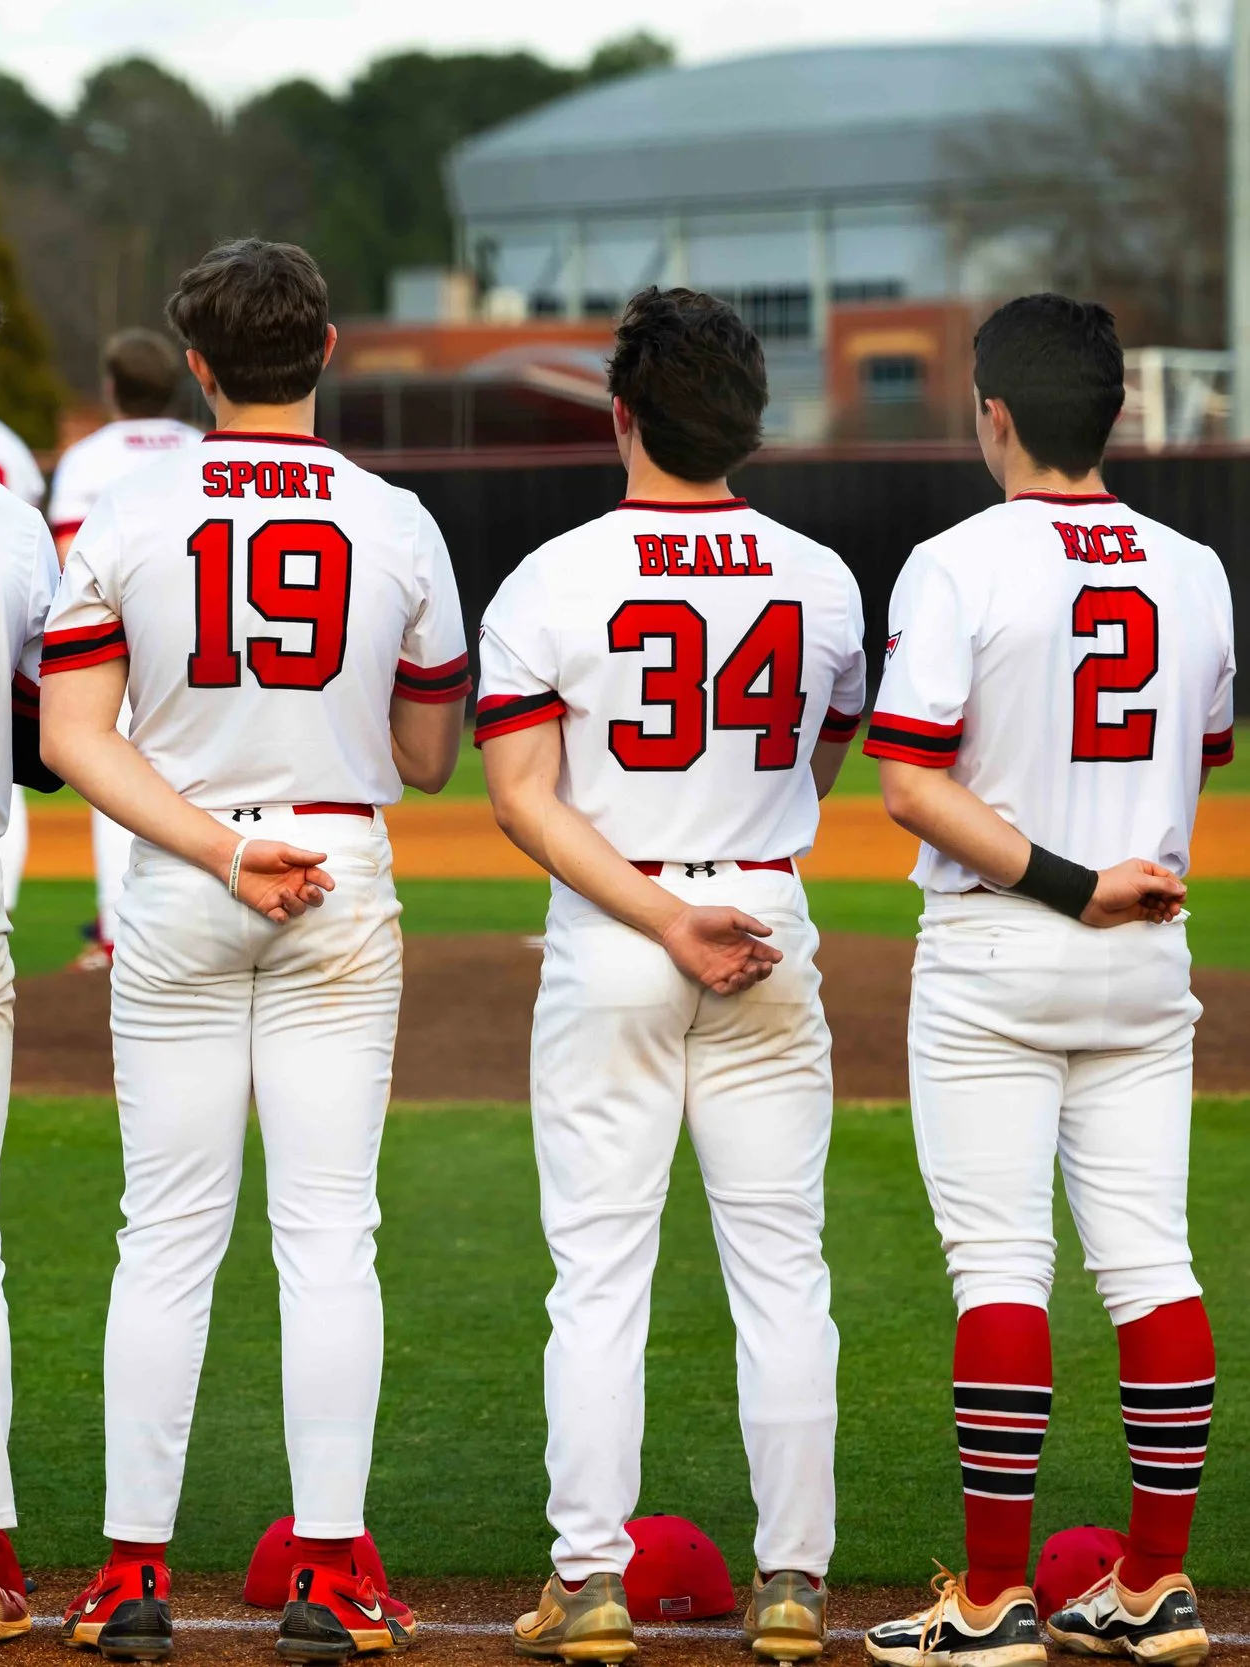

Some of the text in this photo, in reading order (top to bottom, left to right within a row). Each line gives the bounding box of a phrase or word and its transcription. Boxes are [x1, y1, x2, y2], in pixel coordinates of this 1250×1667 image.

[203, 461, 335, 500] SPORT
[634, 534, 773, 576] BEALL
[1052, 521, 1146, 565] RICE
[187, 519, 352, 691] 19
[607, 600, 807, 772] 34
[1071, 585, 1158, 763] 2
